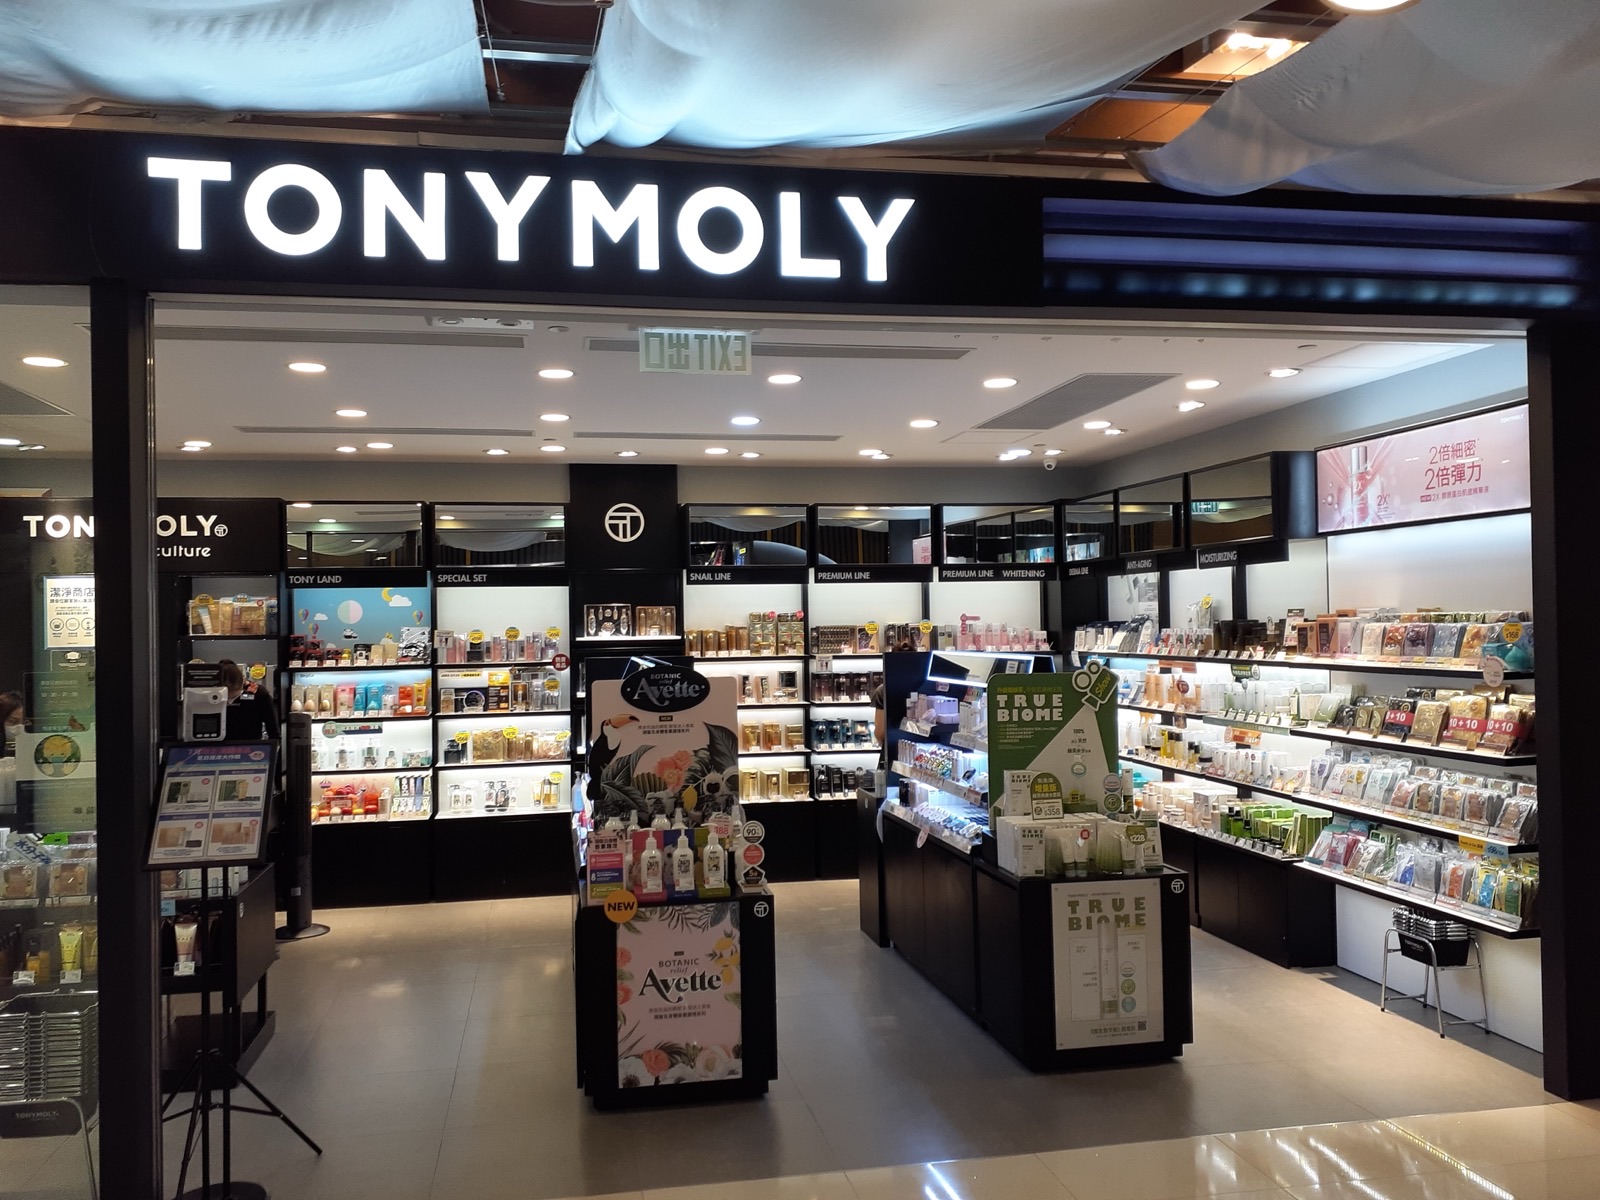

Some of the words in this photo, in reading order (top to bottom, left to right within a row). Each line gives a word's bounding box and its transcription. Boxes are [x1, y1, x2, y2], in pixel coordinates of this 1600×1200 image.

[147, 156, 915, 283] TONYMOLY
[1429, 439, 1476, 465] 2倍細密
[1424, 463, 1482, 490] 2倍彈力
[1377, 494, 1389, 507] 2X
[1200, 551, 1238, 564] MOISTURIZING
[1126, 559, 1152, 570] ANTI-AGING
[289, 575, 315, 584] TONY
[317, 575, 342, 584] LAND
[437, 574, 471, 583] SPECIAL
[473, 574, 487, 582] SET
[690, 573, 713, 581] SNAIL
[714, 572, 731, 580] LINE
[818, 572, 853, 580] PREMIUM
[854, 572, 871, 580] LINE
[942, 570, 977, 578] PREMIUM
[978, 570, 994, 578] LINE
[1002, 570, 1046, 578] WHITENING
[50, 587, 95, 598] 潔淨商店
[633, 677, 701, 706] Avette
[997, 694, 1063, 707] TRUE
[997, 709, 1063, 722] BIOME
[607, 901, 636, 912] NEW
[1068, 897, 1146, 914] TRUE
[658, 958, 700, 968] BOTANIC
[638, 968, 722, 1004] Avette
